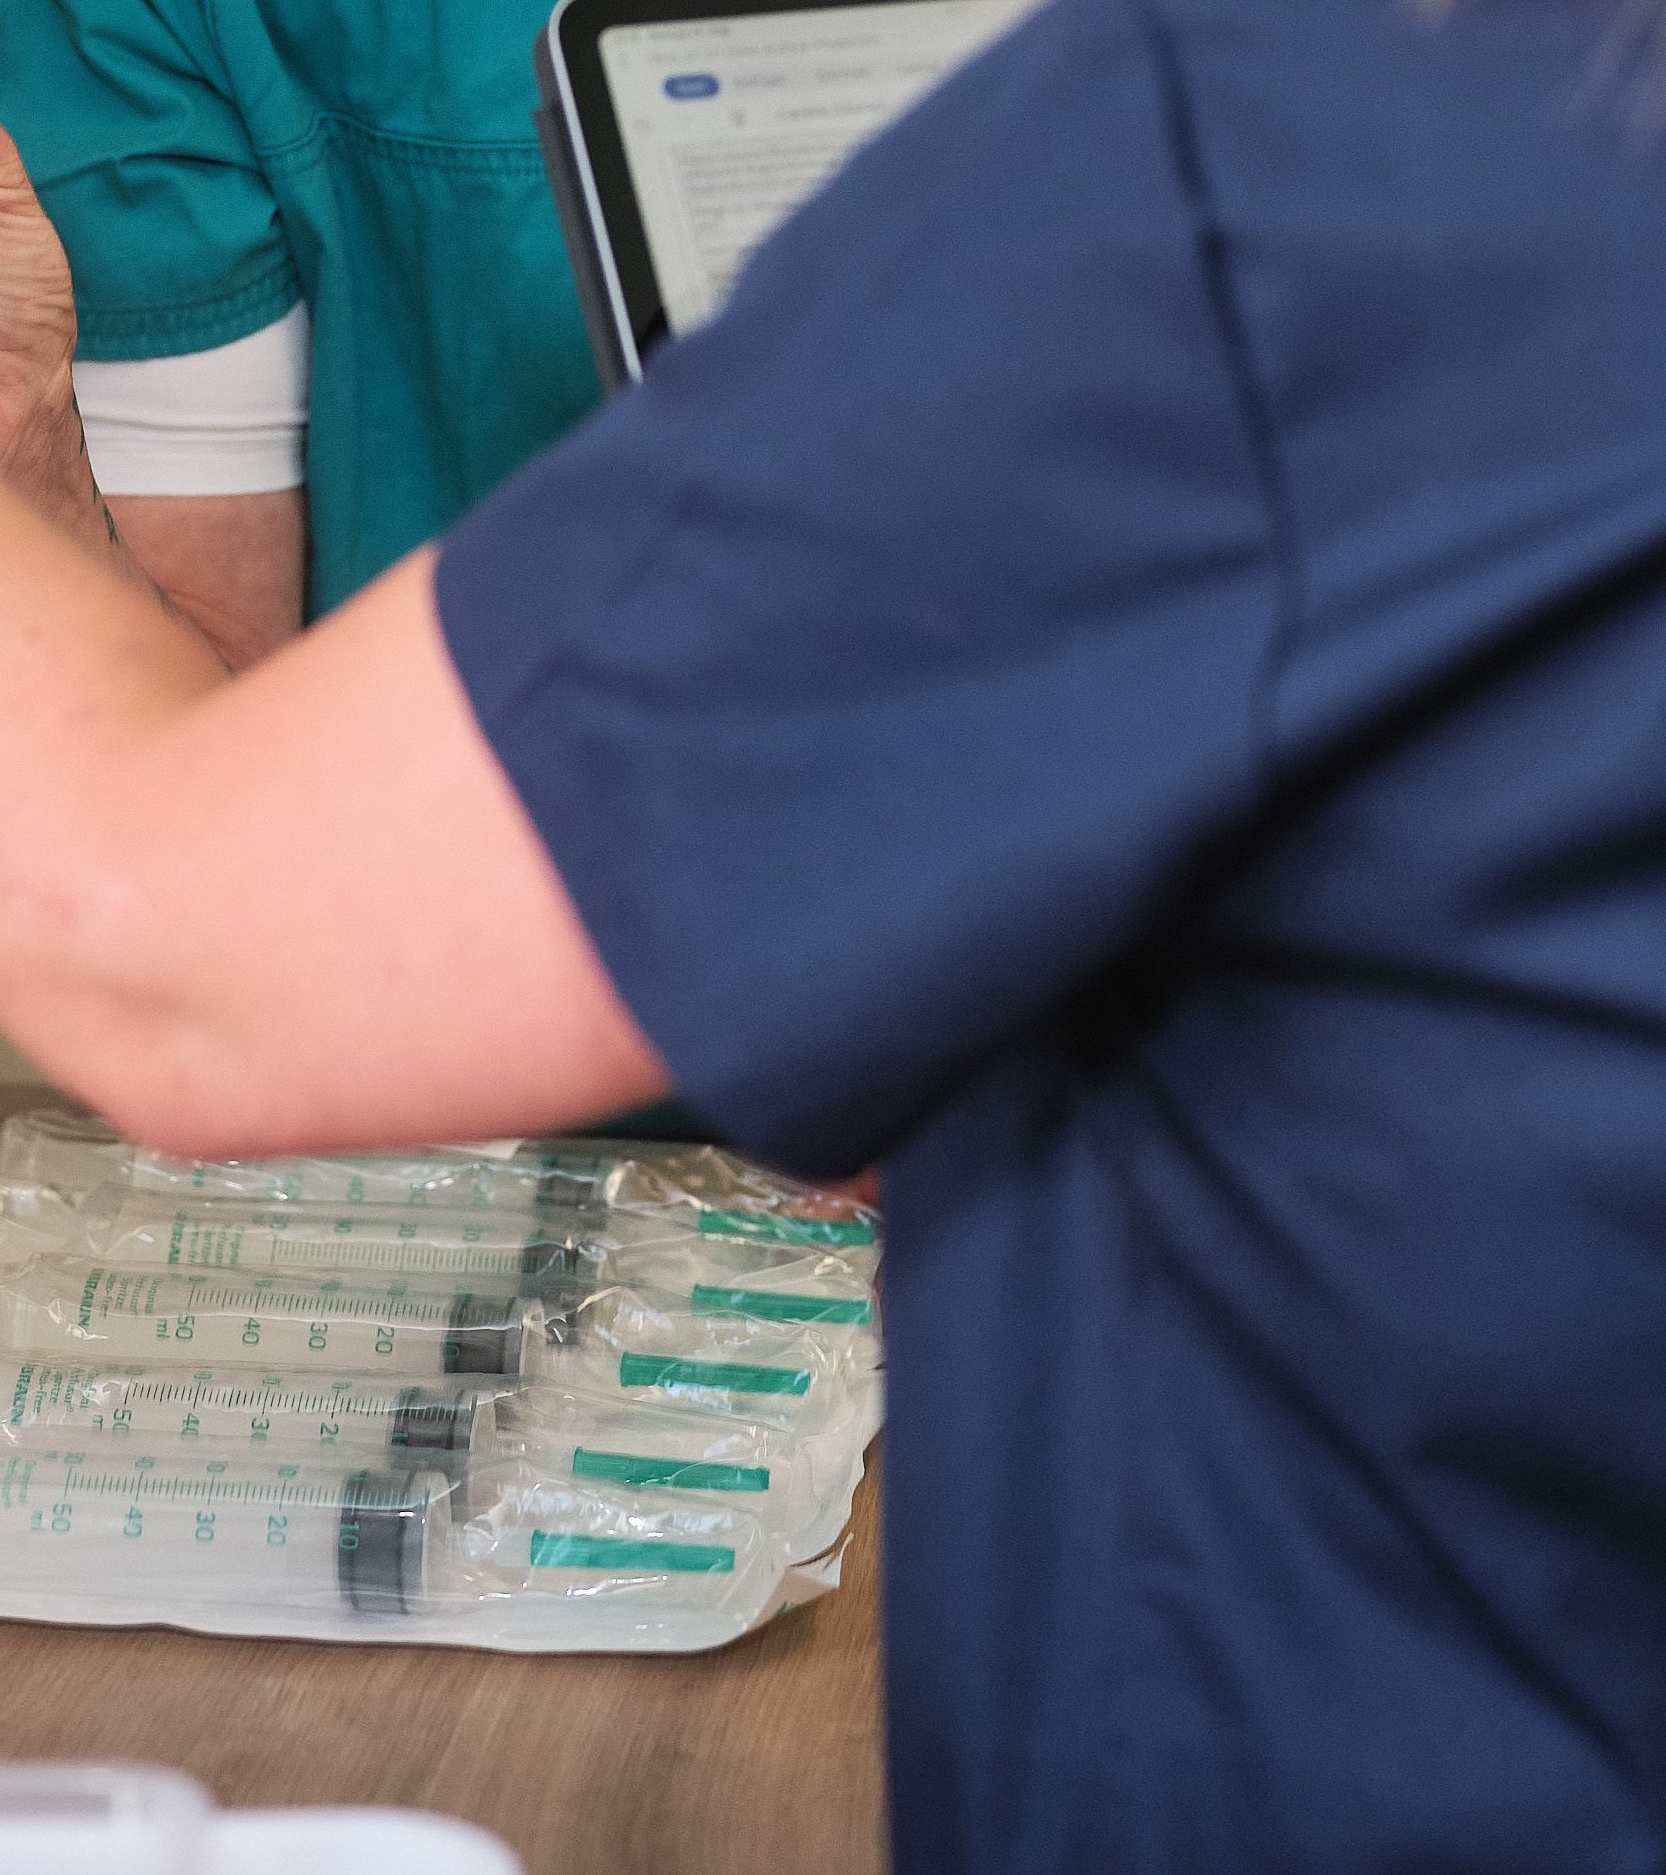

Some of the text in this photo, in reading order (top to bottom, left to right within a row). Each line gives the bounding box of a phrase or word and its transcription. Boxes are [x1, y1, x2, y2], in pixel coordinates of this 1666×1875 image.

[175, 1313, 195, 1342] 50
[241, 1316, 261, 1346] 40
[308, 1322, 328, 1351] 30
[375, 1327, 395, 1356] 20
[51, 1503, 73, 1533] 50
[124, 1505, 143, 1537] 40
[195, 1510, 215, 1542] 30
[267, 1515, 287, 1547] 20
[339, 1522, 360, 1550] 10
